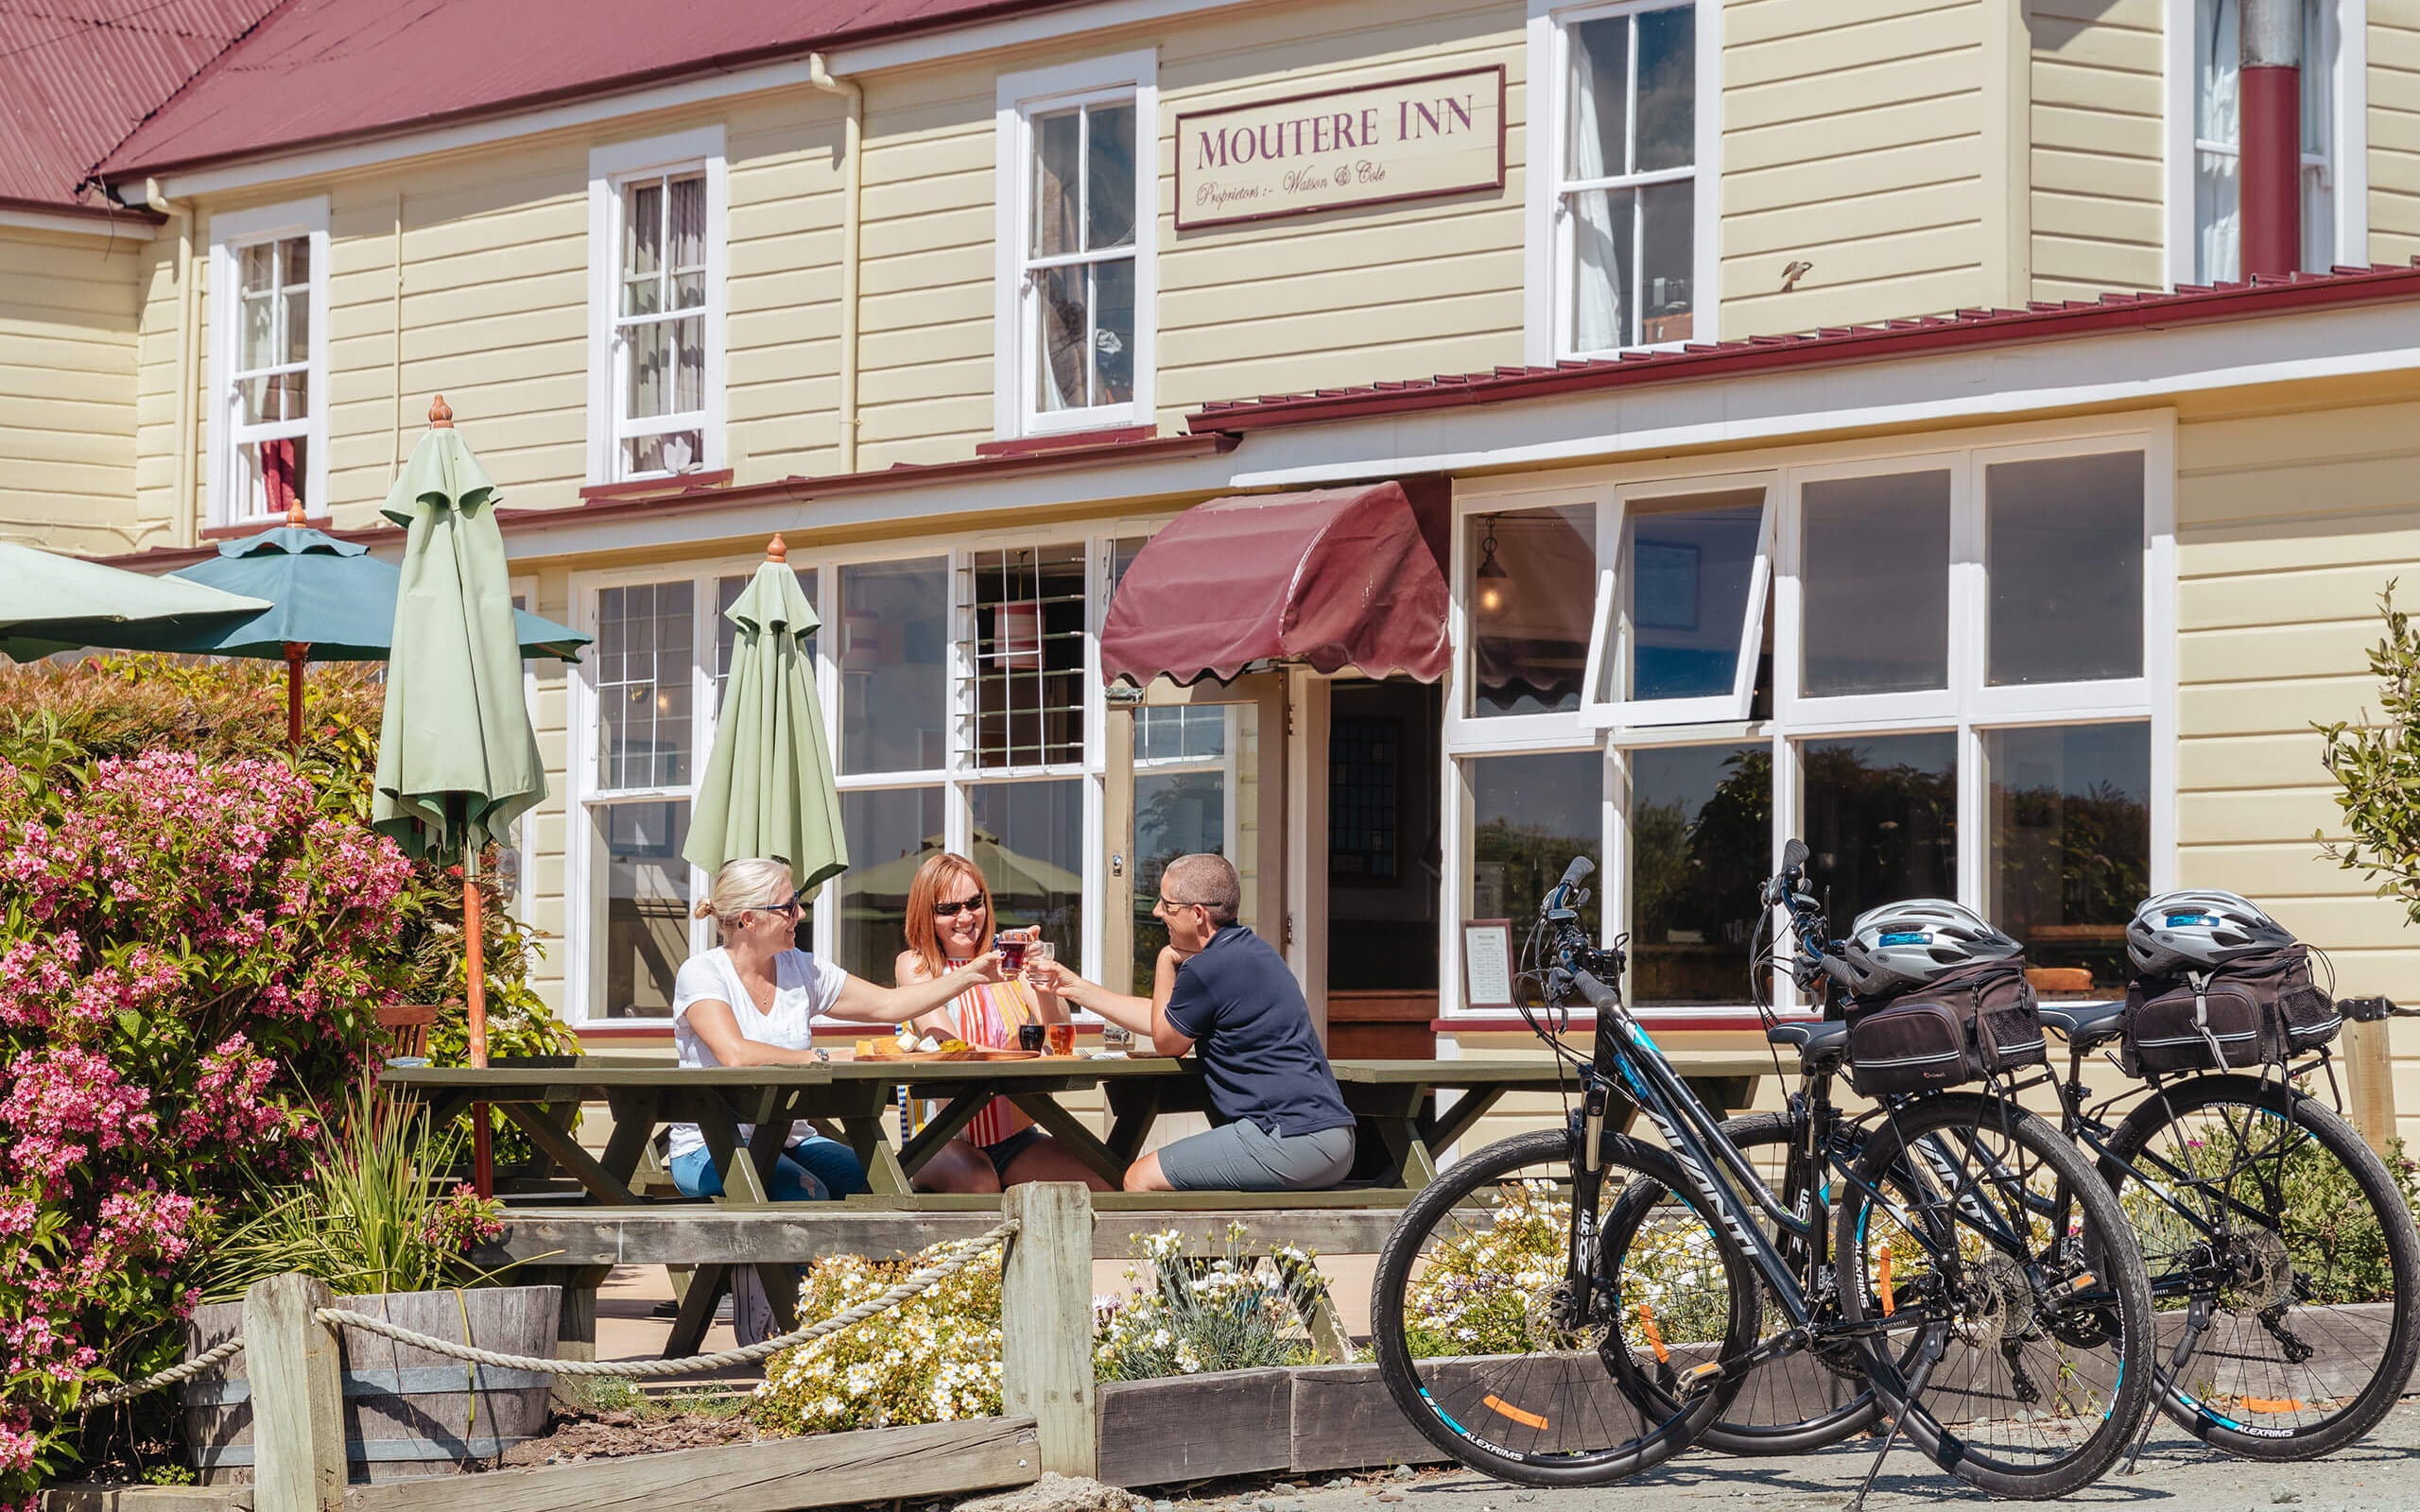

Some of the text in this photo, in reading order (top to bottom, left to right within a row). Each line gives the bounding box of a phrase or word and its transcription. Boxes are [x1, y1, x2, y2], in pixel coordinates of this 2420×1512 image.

[1196, 94, 1475, 170] MOUTERE INN
[1283, 165, 1327, 195] Watson
[1356, 159, 1386, 184] Cole
[1644, 1108, 1759, 1255] AVANTI
[1855, 1239, 1870, 1309] ALEXRIMS
[1461, 1432, 1524, 1461] ALEXRIMS
[2234, 1425, 2295, 1437] ALEXRIMS
